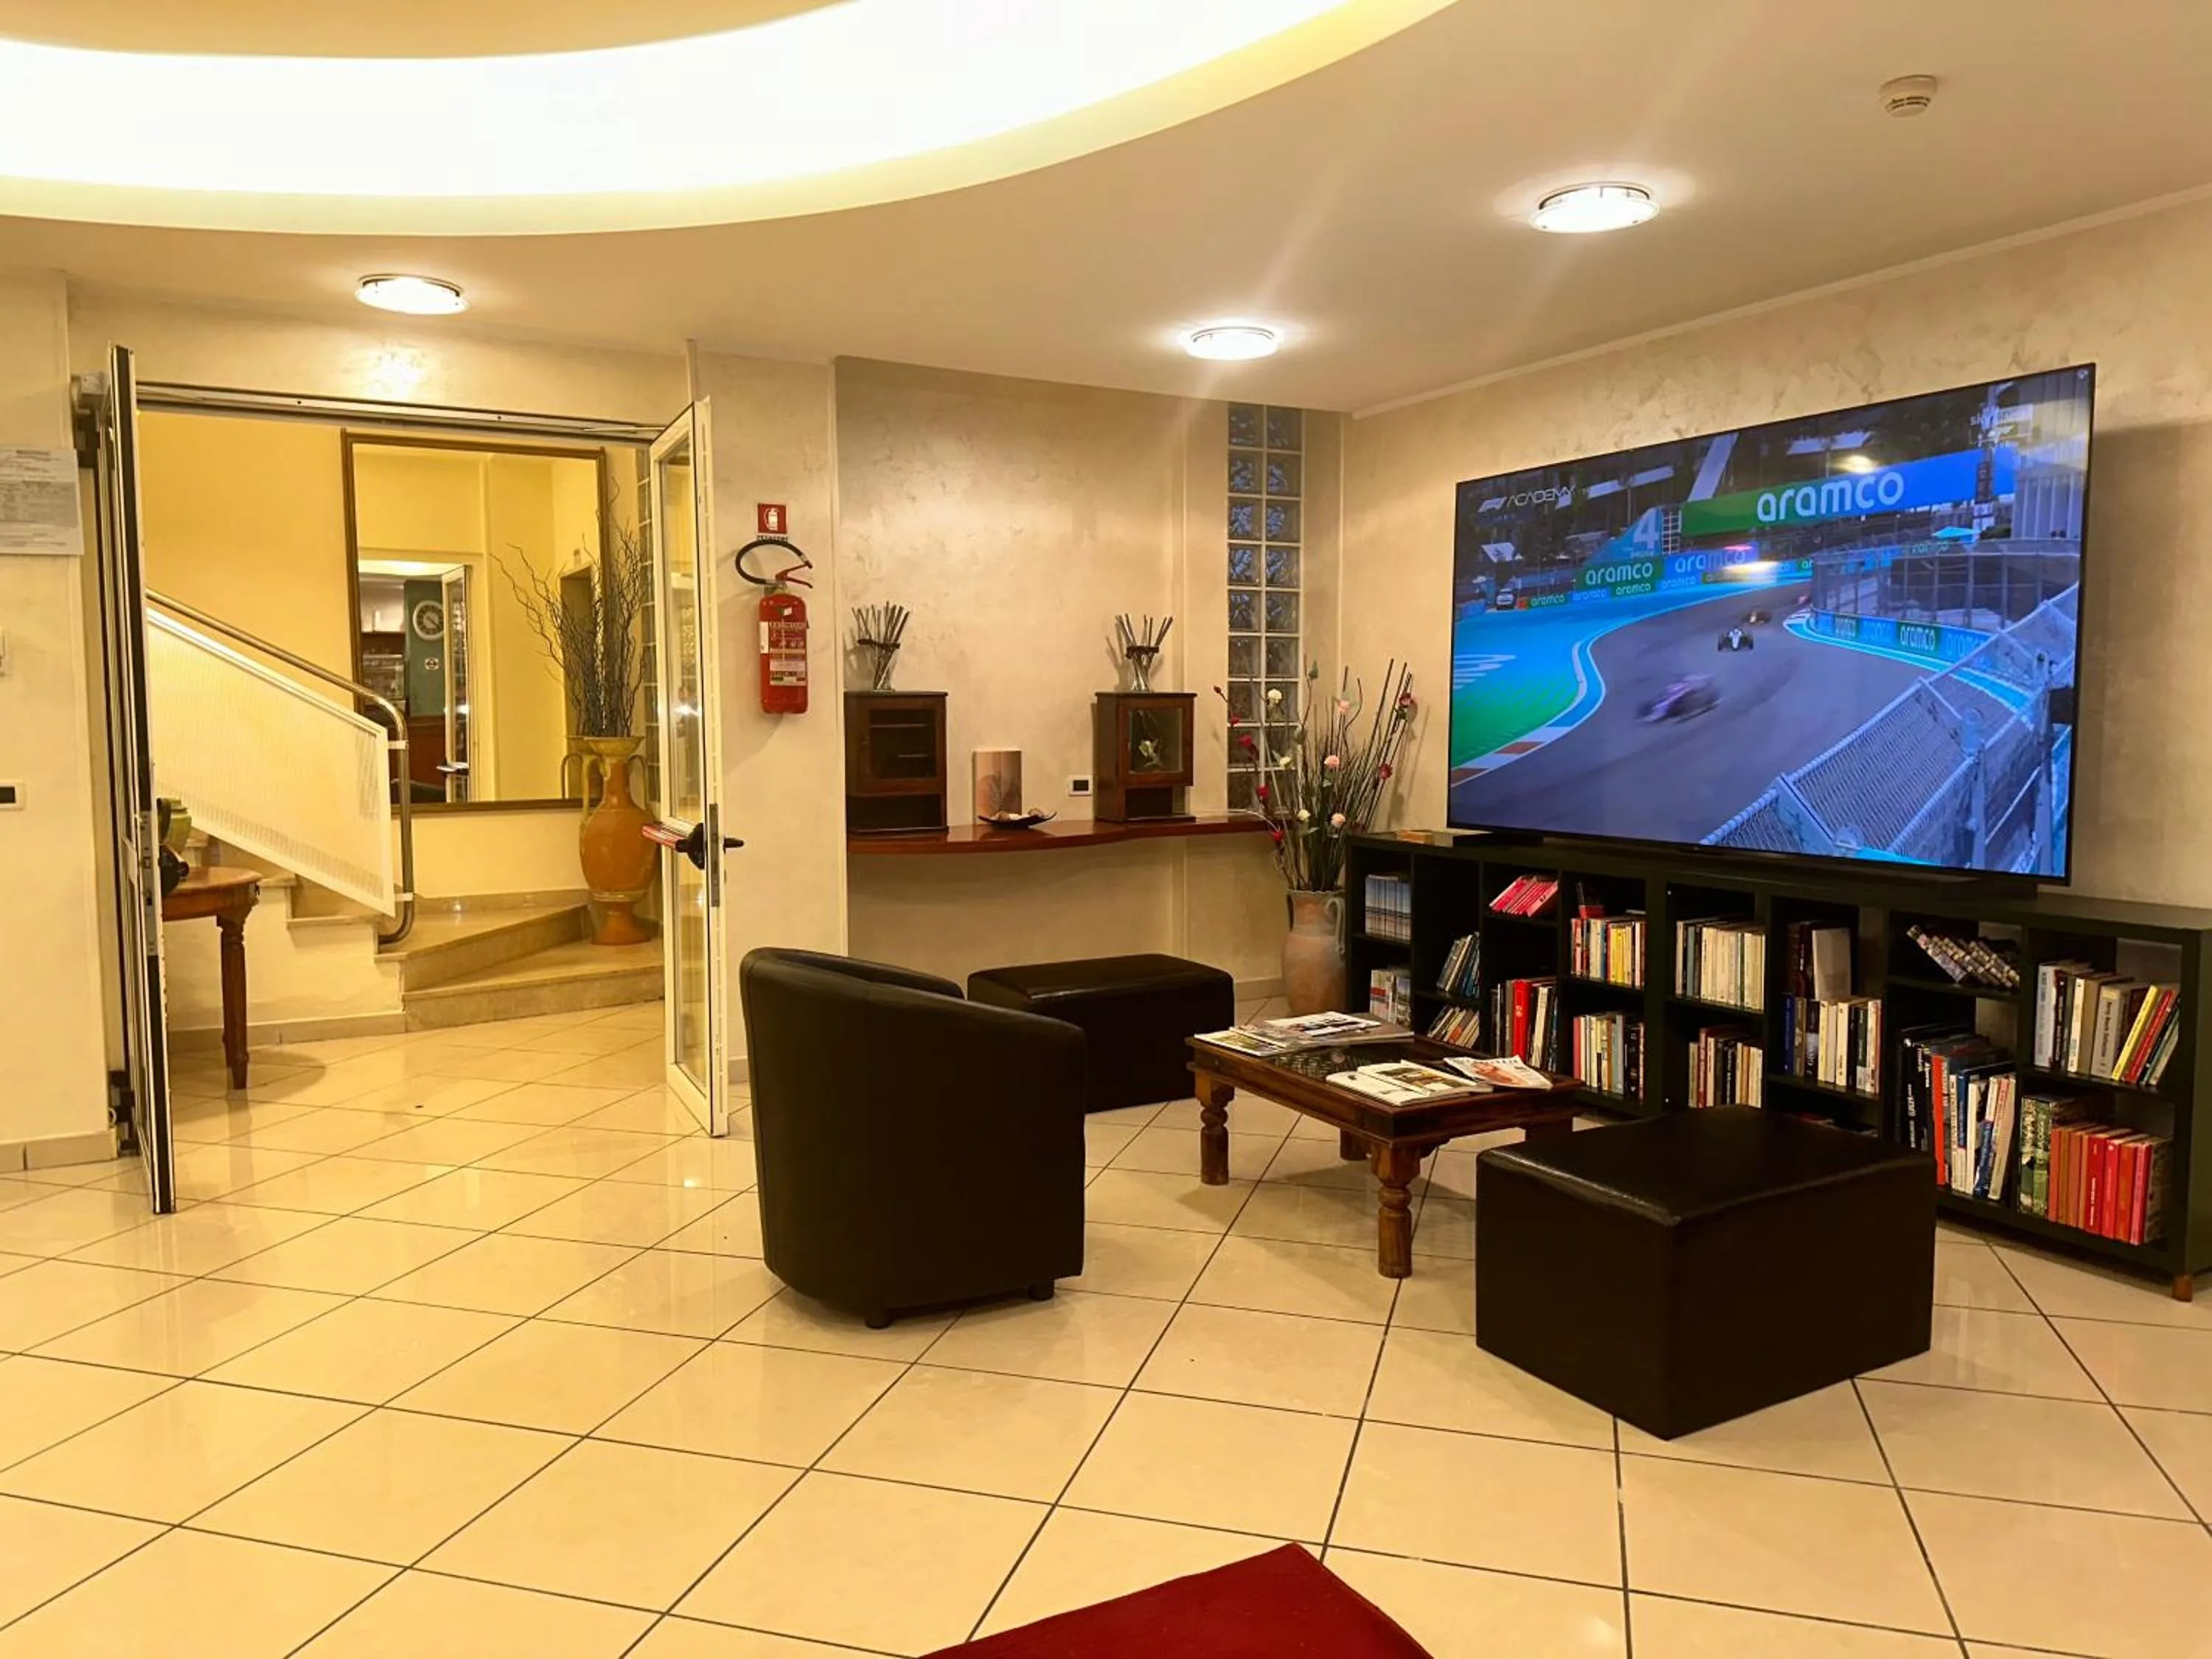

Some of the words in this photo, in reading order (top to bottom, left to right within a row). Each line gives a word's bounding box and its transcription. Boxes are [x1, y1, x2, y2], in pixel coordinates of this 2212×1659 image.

[1757, 471, 1905, 522] aramco
[1633, 507, 1659, 550] 4
[1585, 562, 1652, 585] aramco
[1674, 551, 1746, 574] aramco
[1531, 594, 1565, 607] aramco
[1615, 582, 1651, 596] aramco
[1899, 625, 1935, 652] aramco
